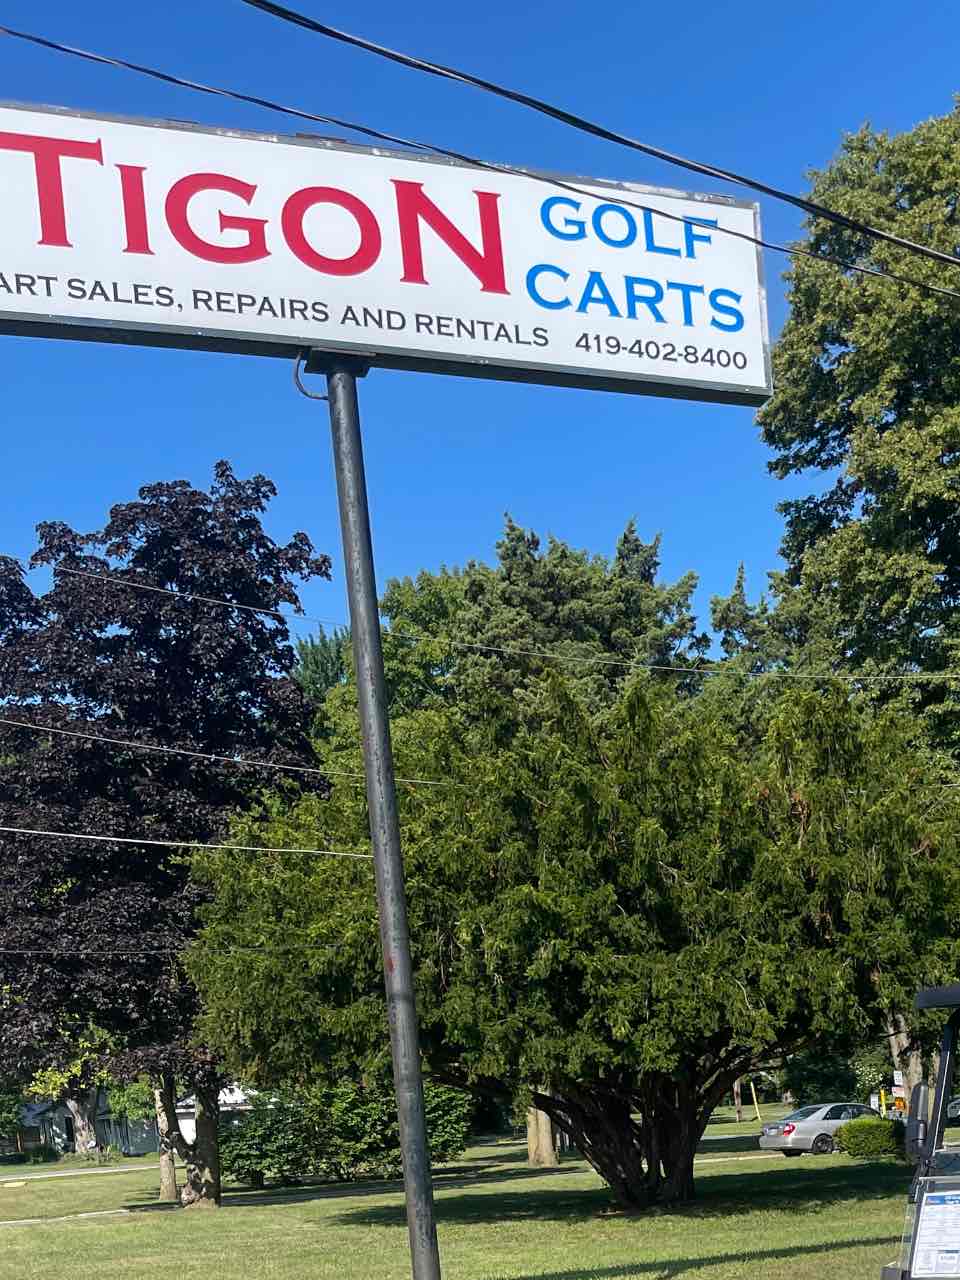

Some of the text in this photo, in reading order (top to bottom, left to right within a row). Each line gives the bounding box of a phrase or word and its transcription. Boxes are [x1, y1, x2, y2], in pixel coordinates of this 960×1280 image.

[0, 132, 509, 294] TIGON
[540, 196, 718, 259] GOLF
[67, 278, 183, 312] SALES,
[192, 289, 330, 322] REPAIRS
[340, 305, 406, 331] AND
[415, 314, 549, 347] RENTALS
[526, 264, 745, 332] CARTS
[575, 333, 747, 370] 419-402-8400
